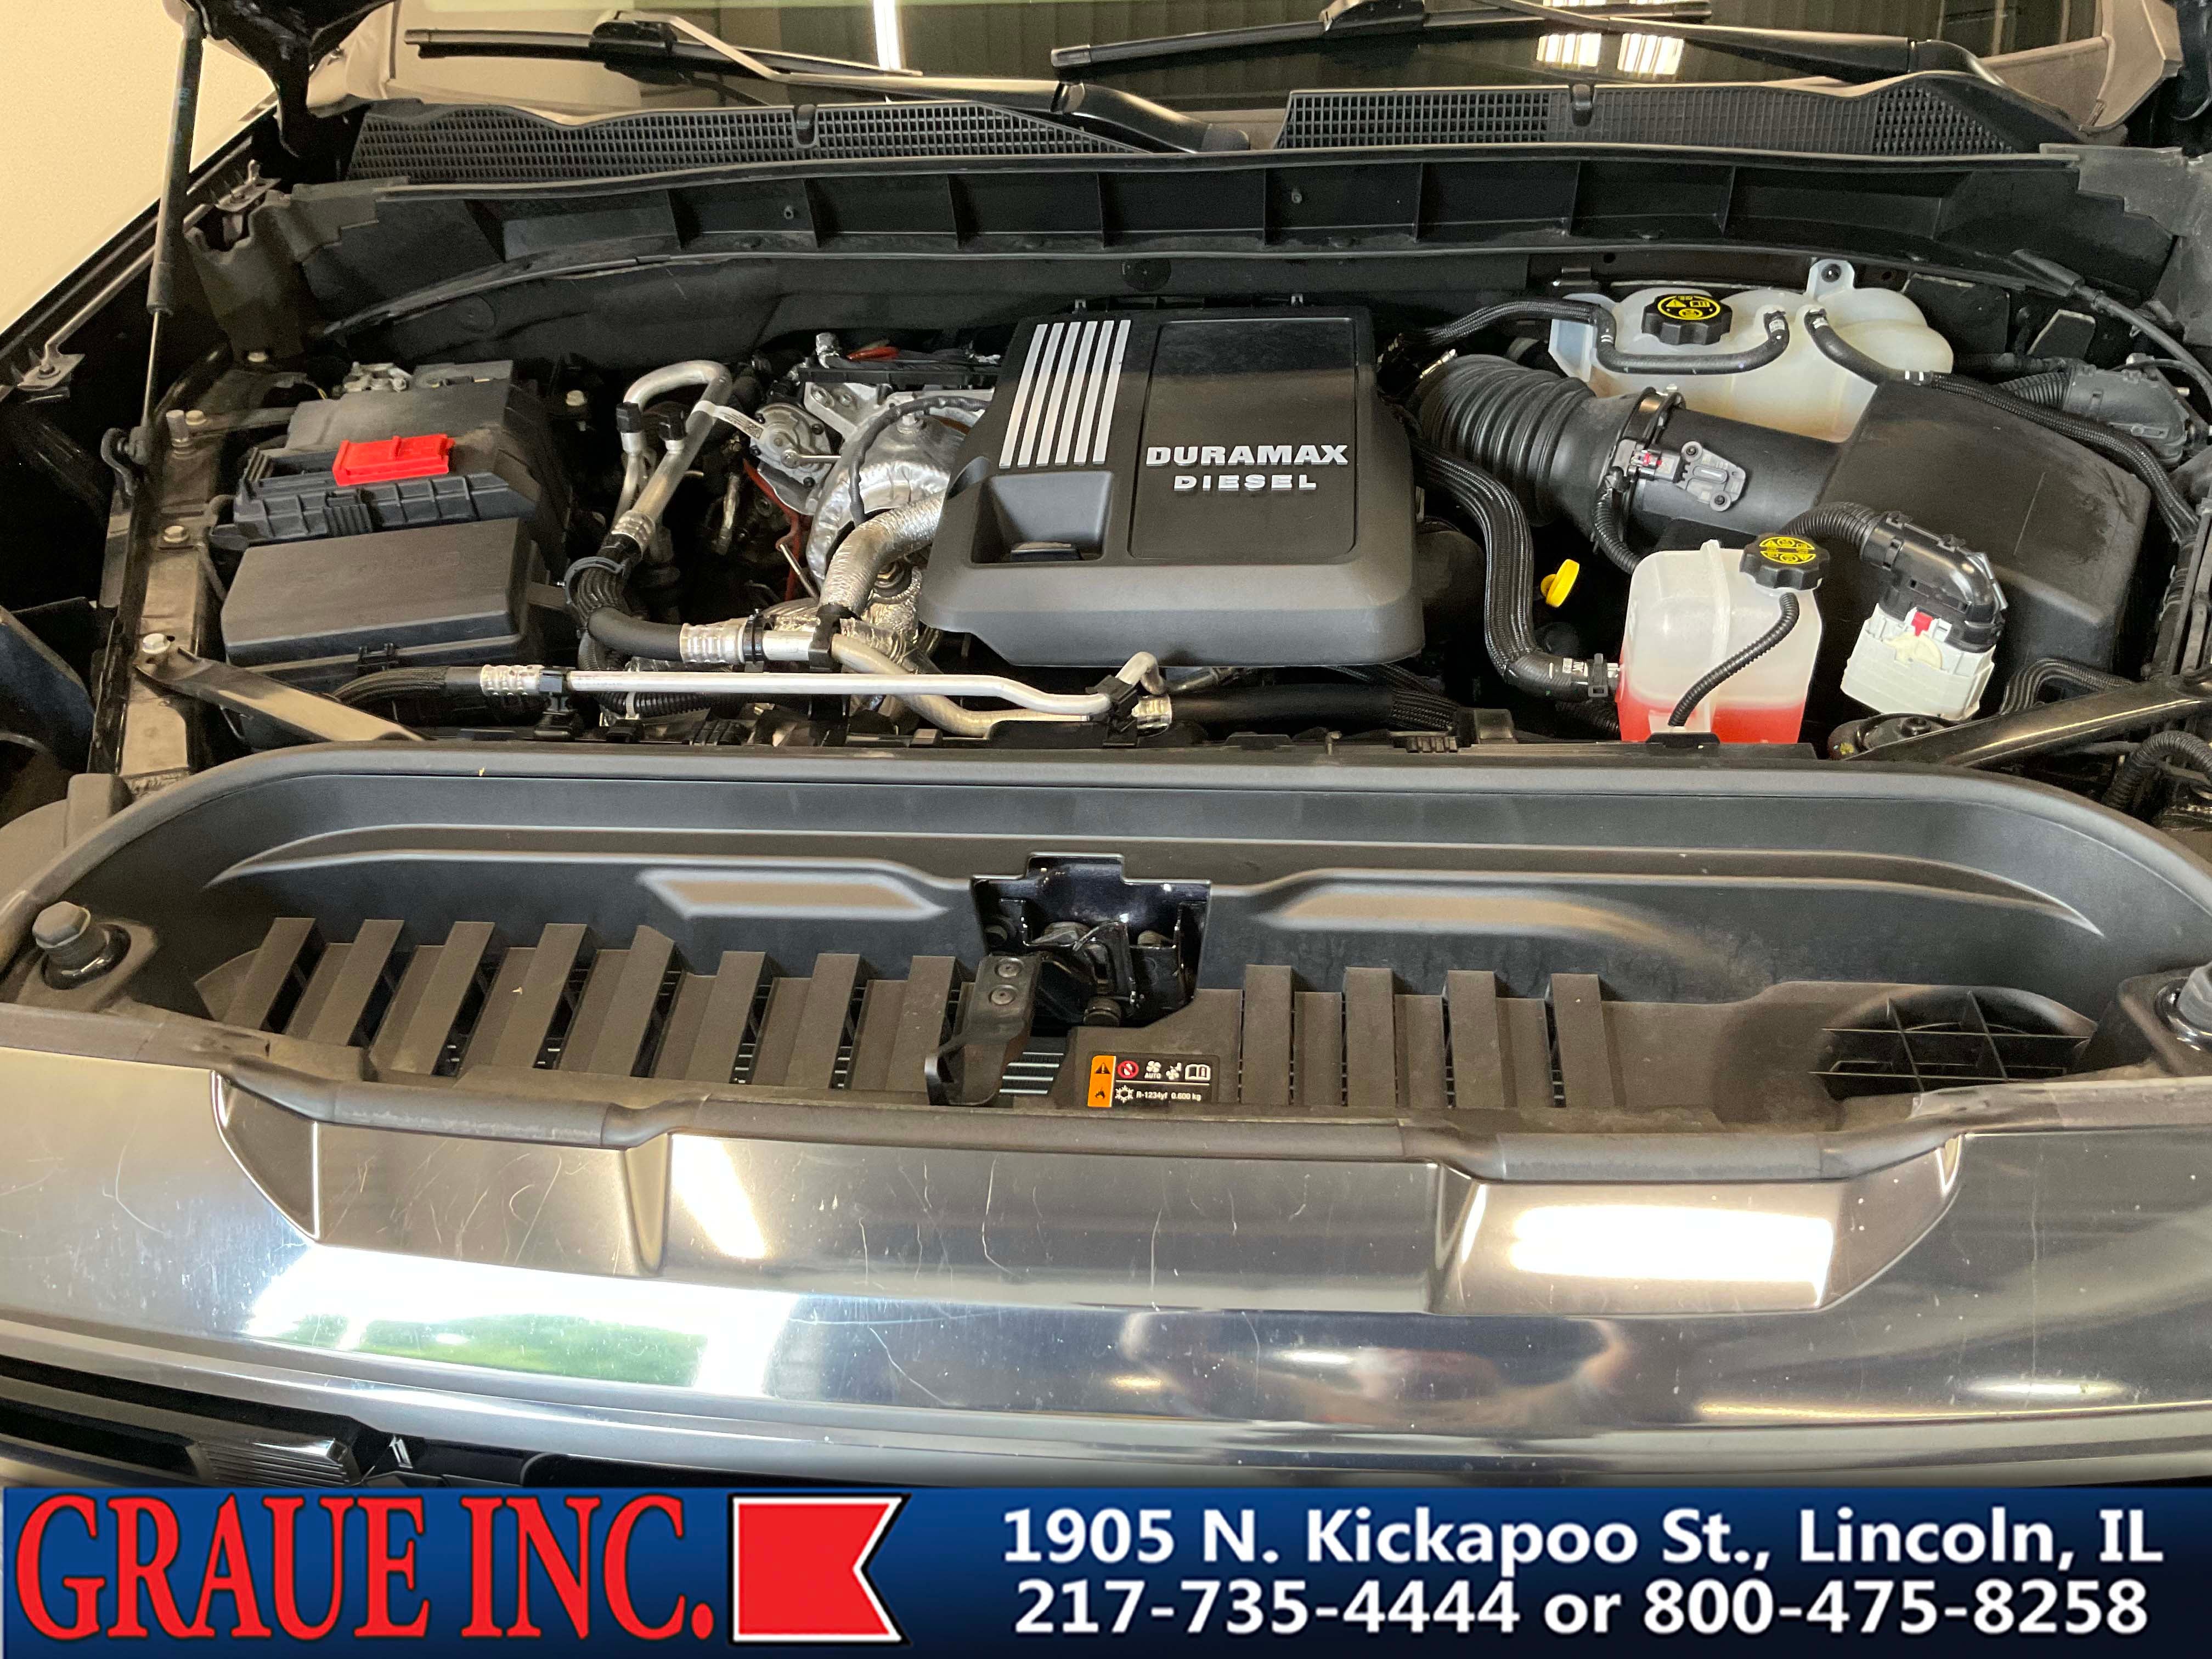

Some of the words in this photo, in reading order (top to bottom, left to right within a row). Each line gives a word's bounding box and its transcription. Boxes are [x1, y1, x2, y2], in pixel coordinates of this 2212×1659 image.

[1146, 445, 1348, 466] DURAMAX
[1173, 475, 1317, 491] DIESEL
[1136, 1091, 1168, 1101] R-1234yf
[1192, 1092, 1201, 1101] kg
